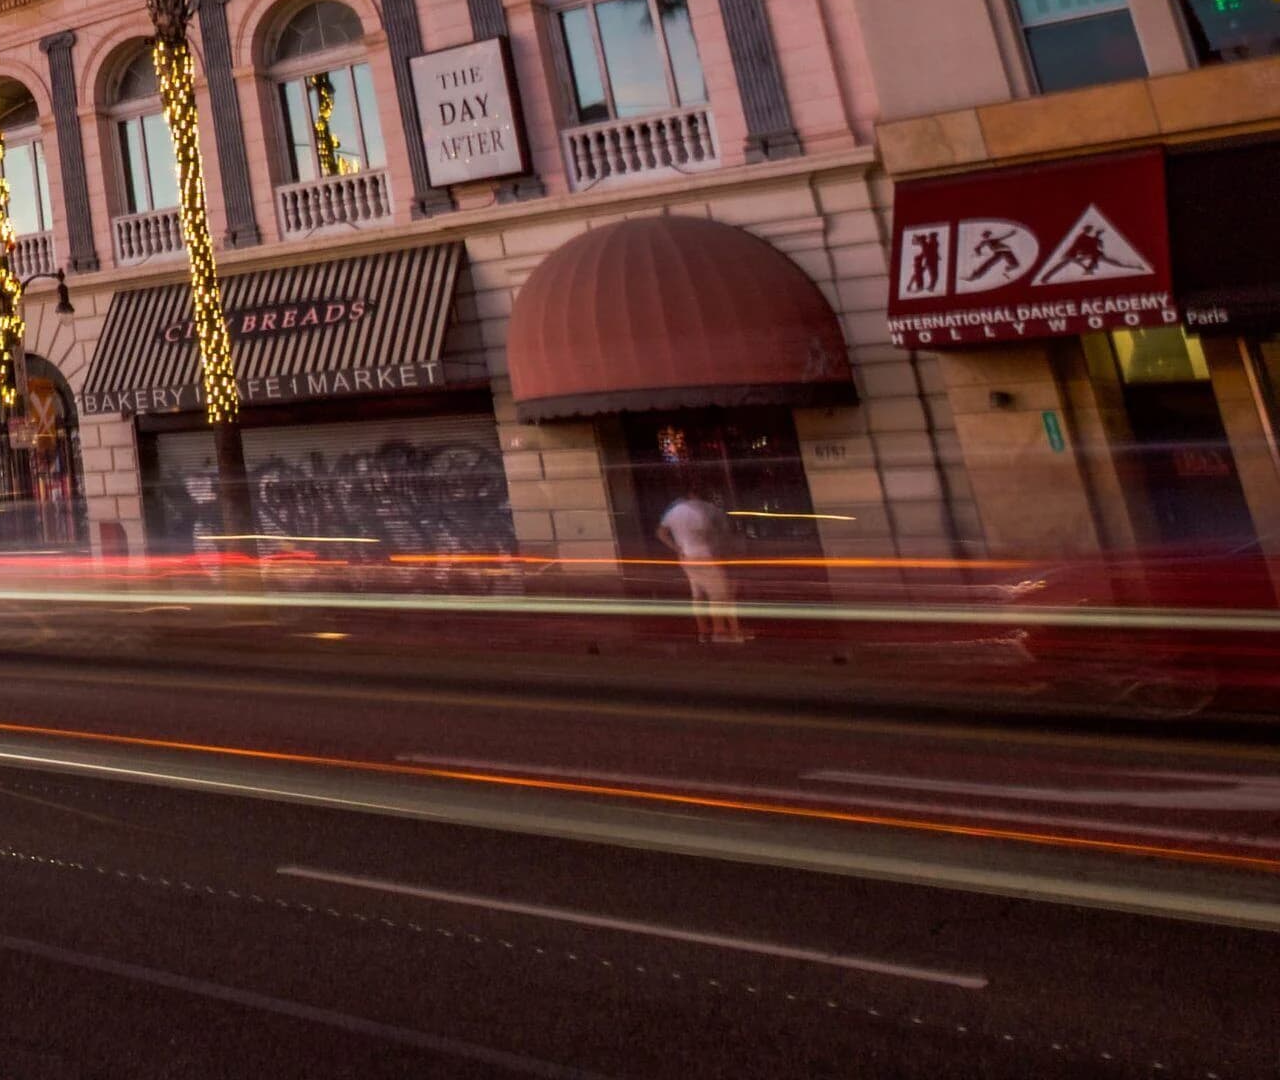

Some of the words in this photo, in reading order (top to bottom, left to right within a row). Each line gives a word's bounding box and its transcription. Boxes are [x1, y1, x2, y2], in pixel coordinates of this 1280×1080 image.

[435, 66, 484, 90] THE
[438, 93, 489, 126] DAY
[439, 130, 505, 163] AFTER
[241, 300, 366, 334] BREADS
[888, 309, 1017, 333] INTERNATIONAL
[1018, 300, 1078, 321] DANCE
[1080, 294, 1169, 315] ACADEMY
[891, 309, 1177, 346] HOLLYWOOD
[1186, 309, 1229, 327] Paris
[85, 386, 184, 414] BAKERY
[307, 362, 438, 395] MARKET
